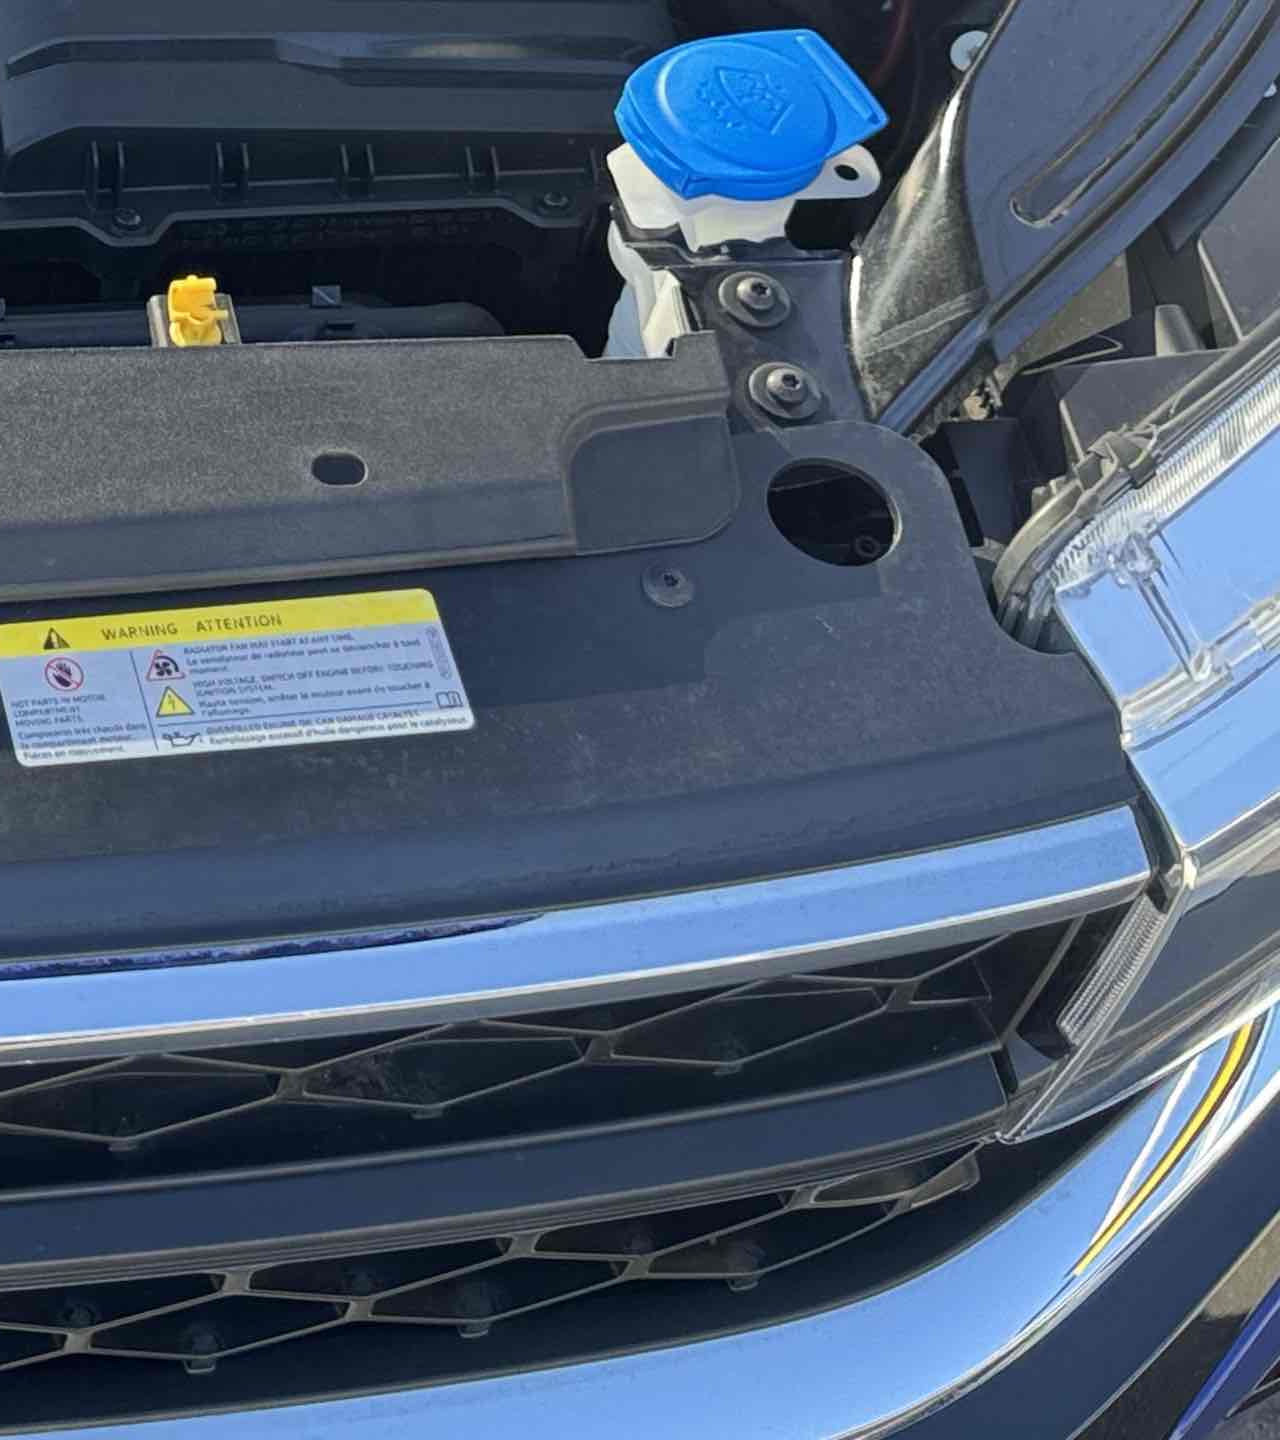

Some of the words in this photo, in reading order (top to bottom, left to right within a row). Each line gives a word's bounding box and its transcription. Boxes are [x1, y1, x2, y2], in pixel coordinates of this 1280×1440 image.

[101, 623, 178, 641] WARNING
[195, 613, 283, 633] ATTENTION
[229, 641, 246, 651] FAN
[315, 667, 349, 678] ENGINE
